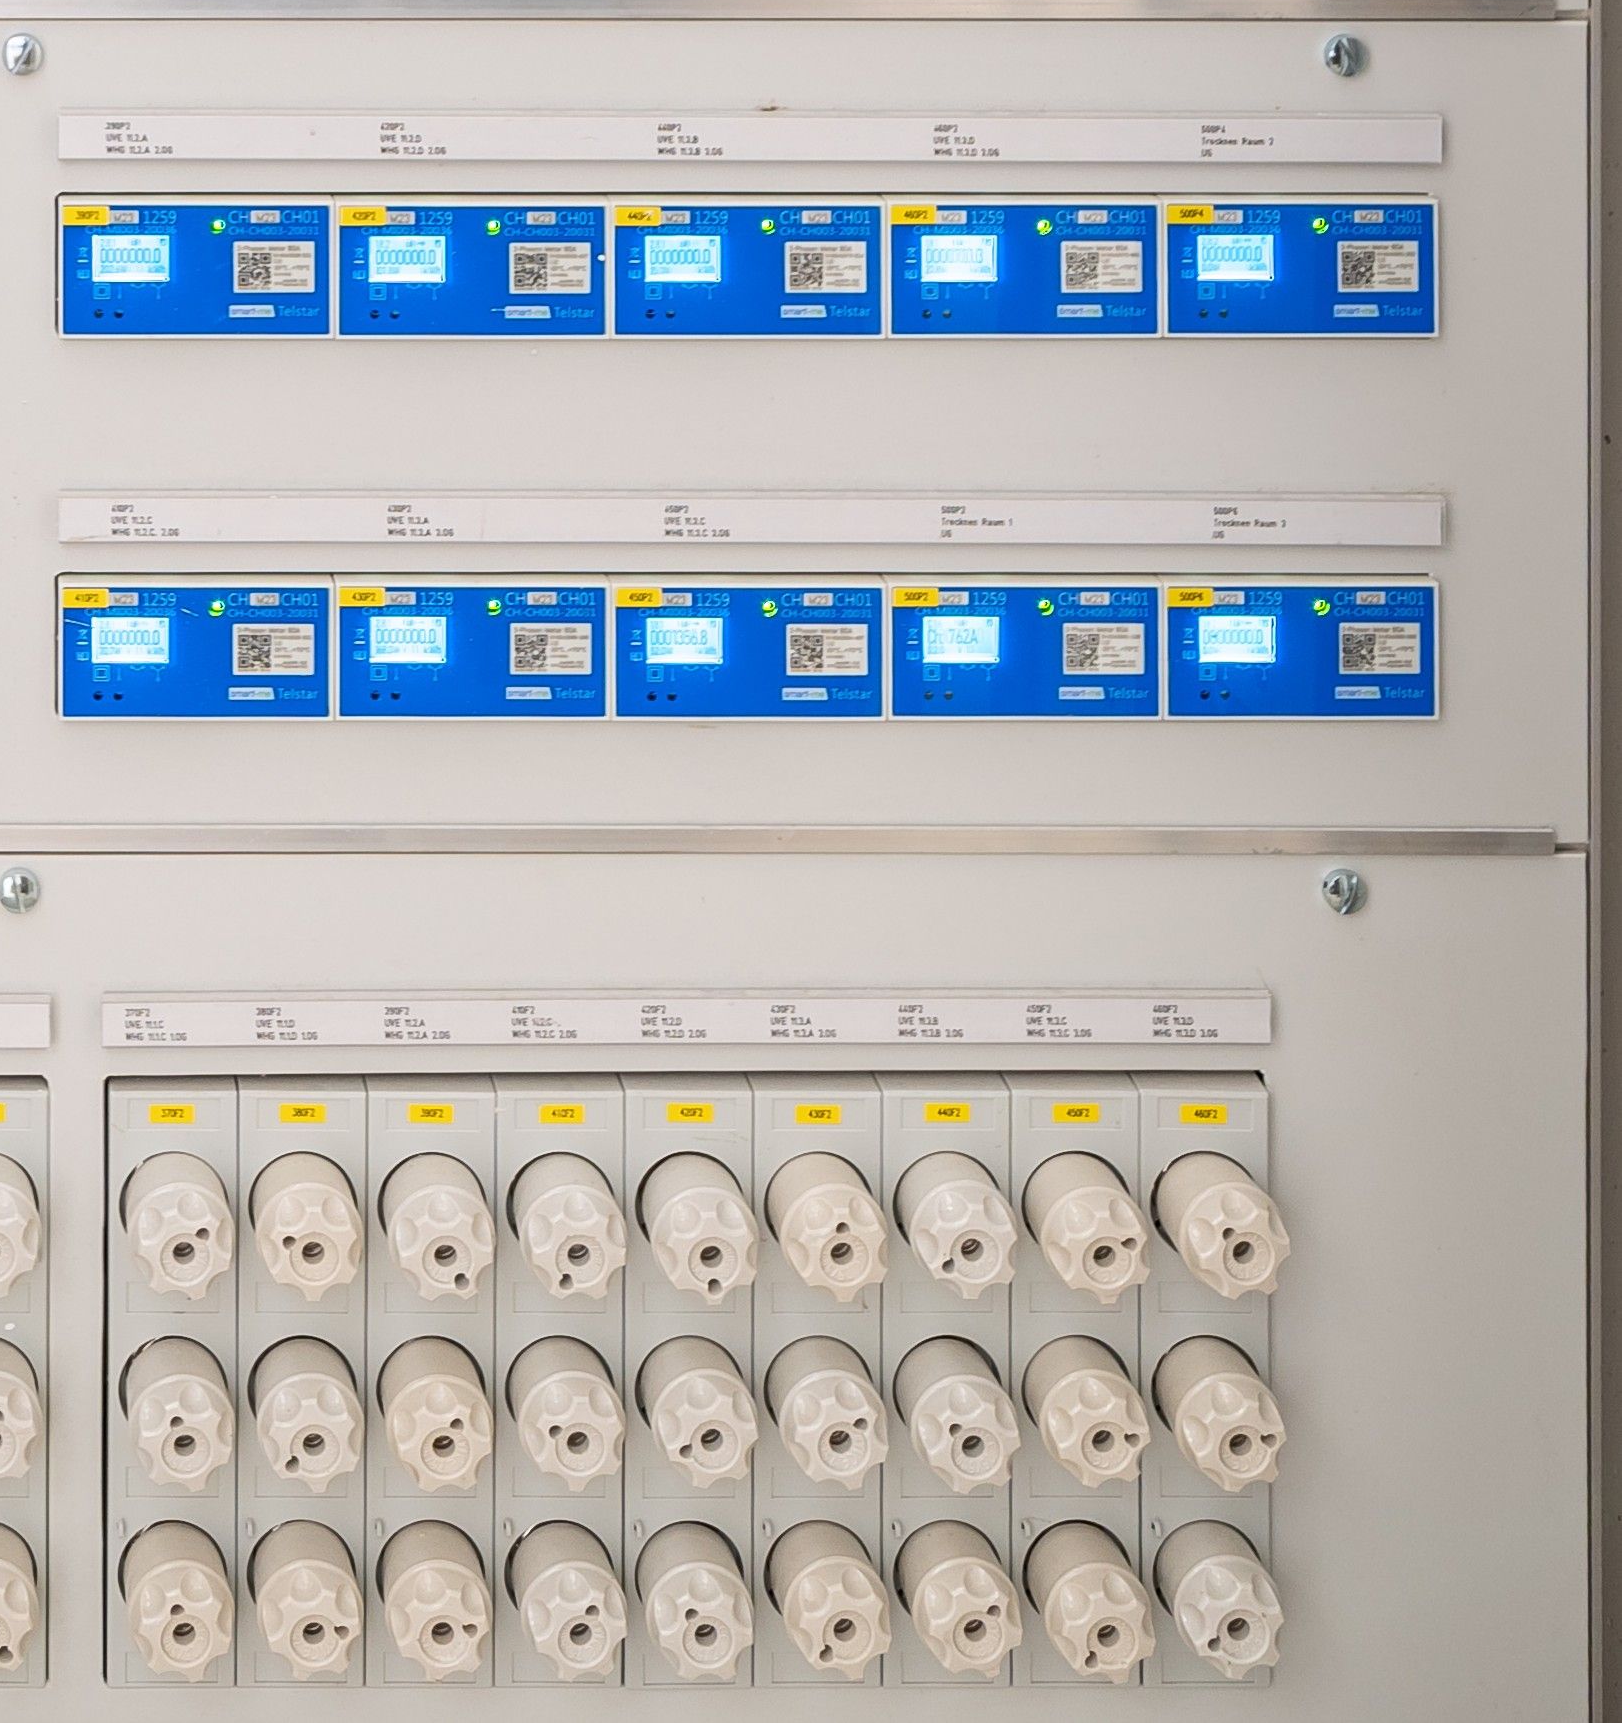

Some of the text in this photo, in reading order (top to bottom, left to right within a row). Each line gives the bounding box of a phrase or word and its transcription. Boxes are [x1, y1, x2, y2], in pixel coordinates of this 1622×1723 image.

[143, 209, 178, 224] 1259
[281, 209, 321, 224] CH01
[419, 210, 454, 225] 1259
[556, 210, 596, 225] CH01
[694, 210, 729, 225] 1259
[832, 209, 872, 224] CH01
[971, 209, 1006, 224] 1259
[1108, 209, 1148, 224] CH01
[1247, 209, 1282, 224] 1259
[1384, 208, 1424, 223] CH01
[554, 305, 596, 319] Telstar
[142, 592, 177, 607] 1259
[280, 591, 320, 606] CH01
[420, 591, 455, 606] 1259
[557, 591, 597, 606] CH01
[696, 592, 731, 607] 1259
[833, 592, 873, 607] CH01
[972, 591, 1007, 606] 1259
[1110, 591, 1150, 606] CH01
[1248, 590, 1283, 605] 1259
[1386, 590, 1426, 605] CH01
